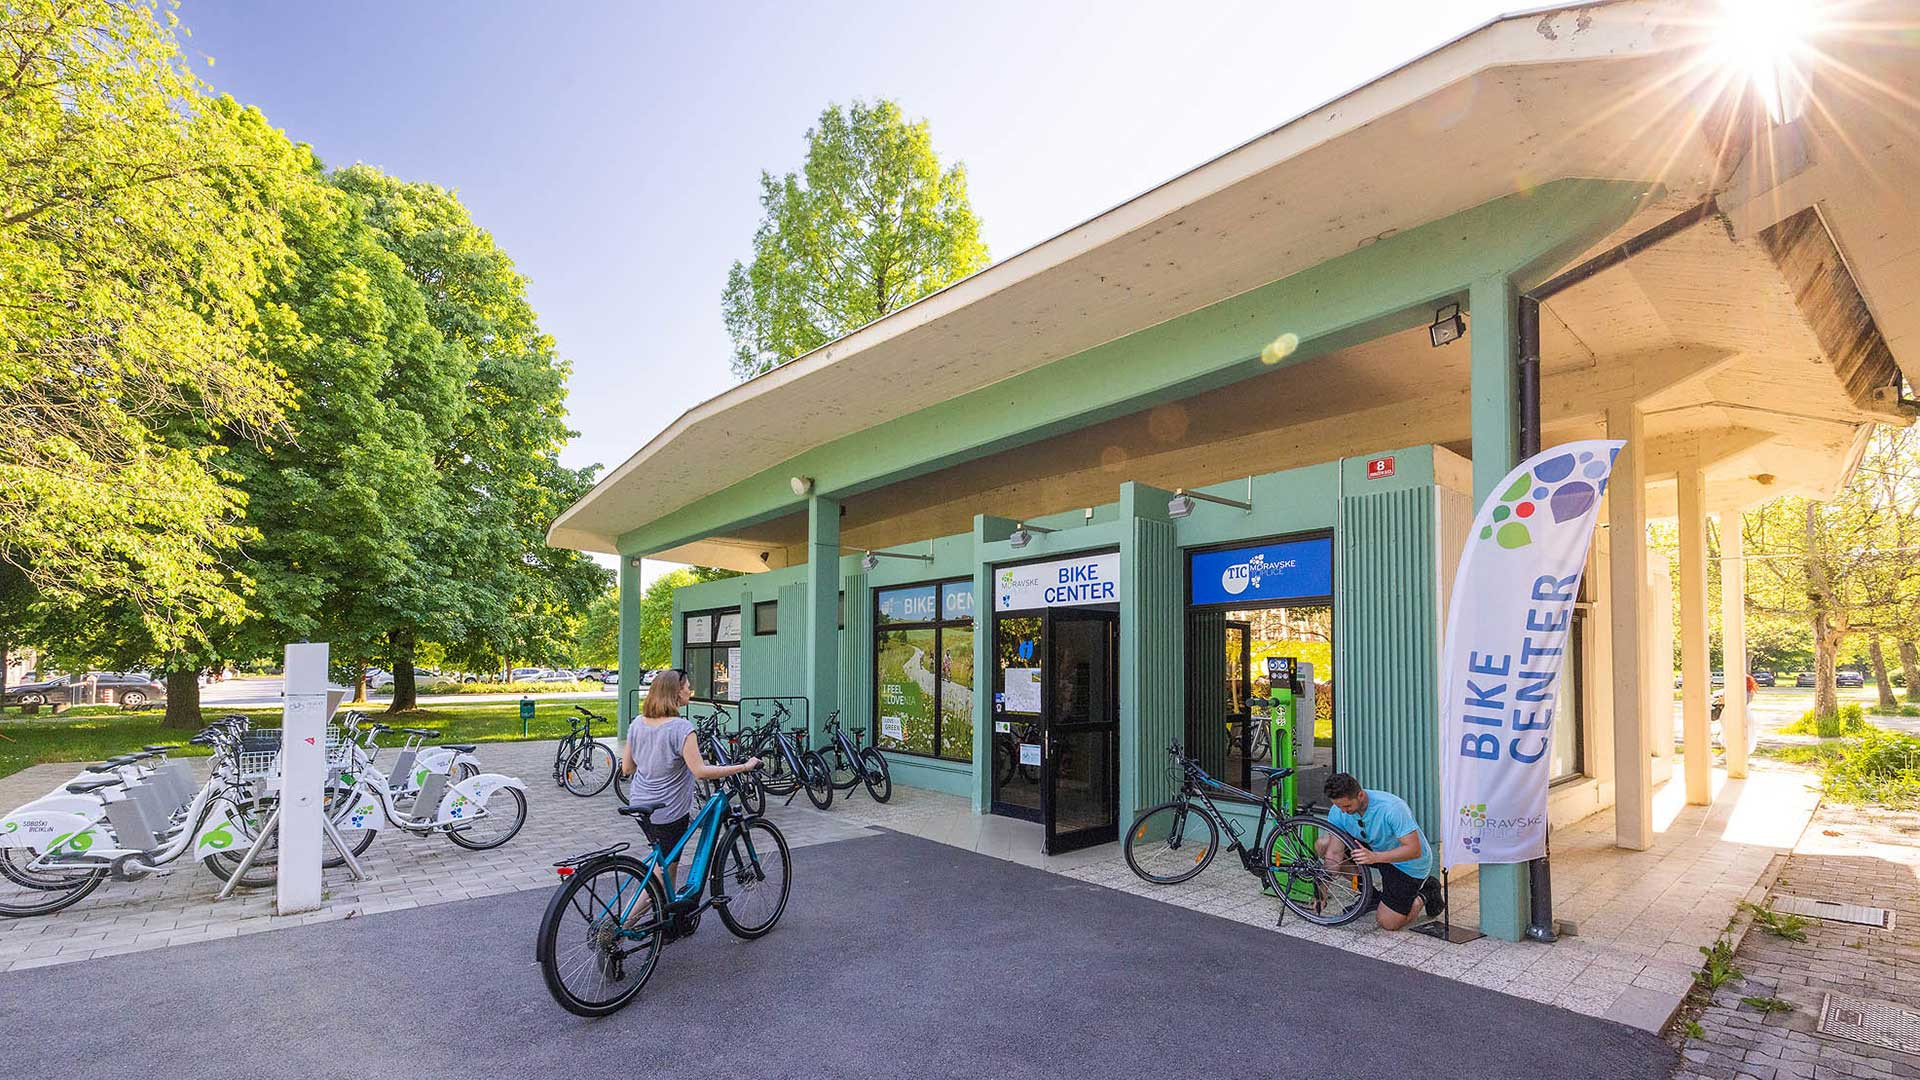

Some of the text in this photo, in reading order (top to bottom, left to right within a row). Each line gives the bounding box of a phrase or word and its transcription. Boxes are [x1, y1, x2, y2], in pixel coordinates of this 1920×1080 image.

[1377, 460, 1385, 471] 8
[1227, 566, 1248, 579] TIC
[1250, 559, 1296, 571] MORAVSKE
[1058, 564, 1098, 584] BIKE
[1044, 581, 1115, 603] CENTER
[904, 595, 936, 614] BIKE
[1509, 573, 1578, 764] CENTER
[887, 684, 903, 694] FEEL
[1460, 651, 1511, 761] BIKE
[1460, 814, 1543, 829] MORAVSKE
